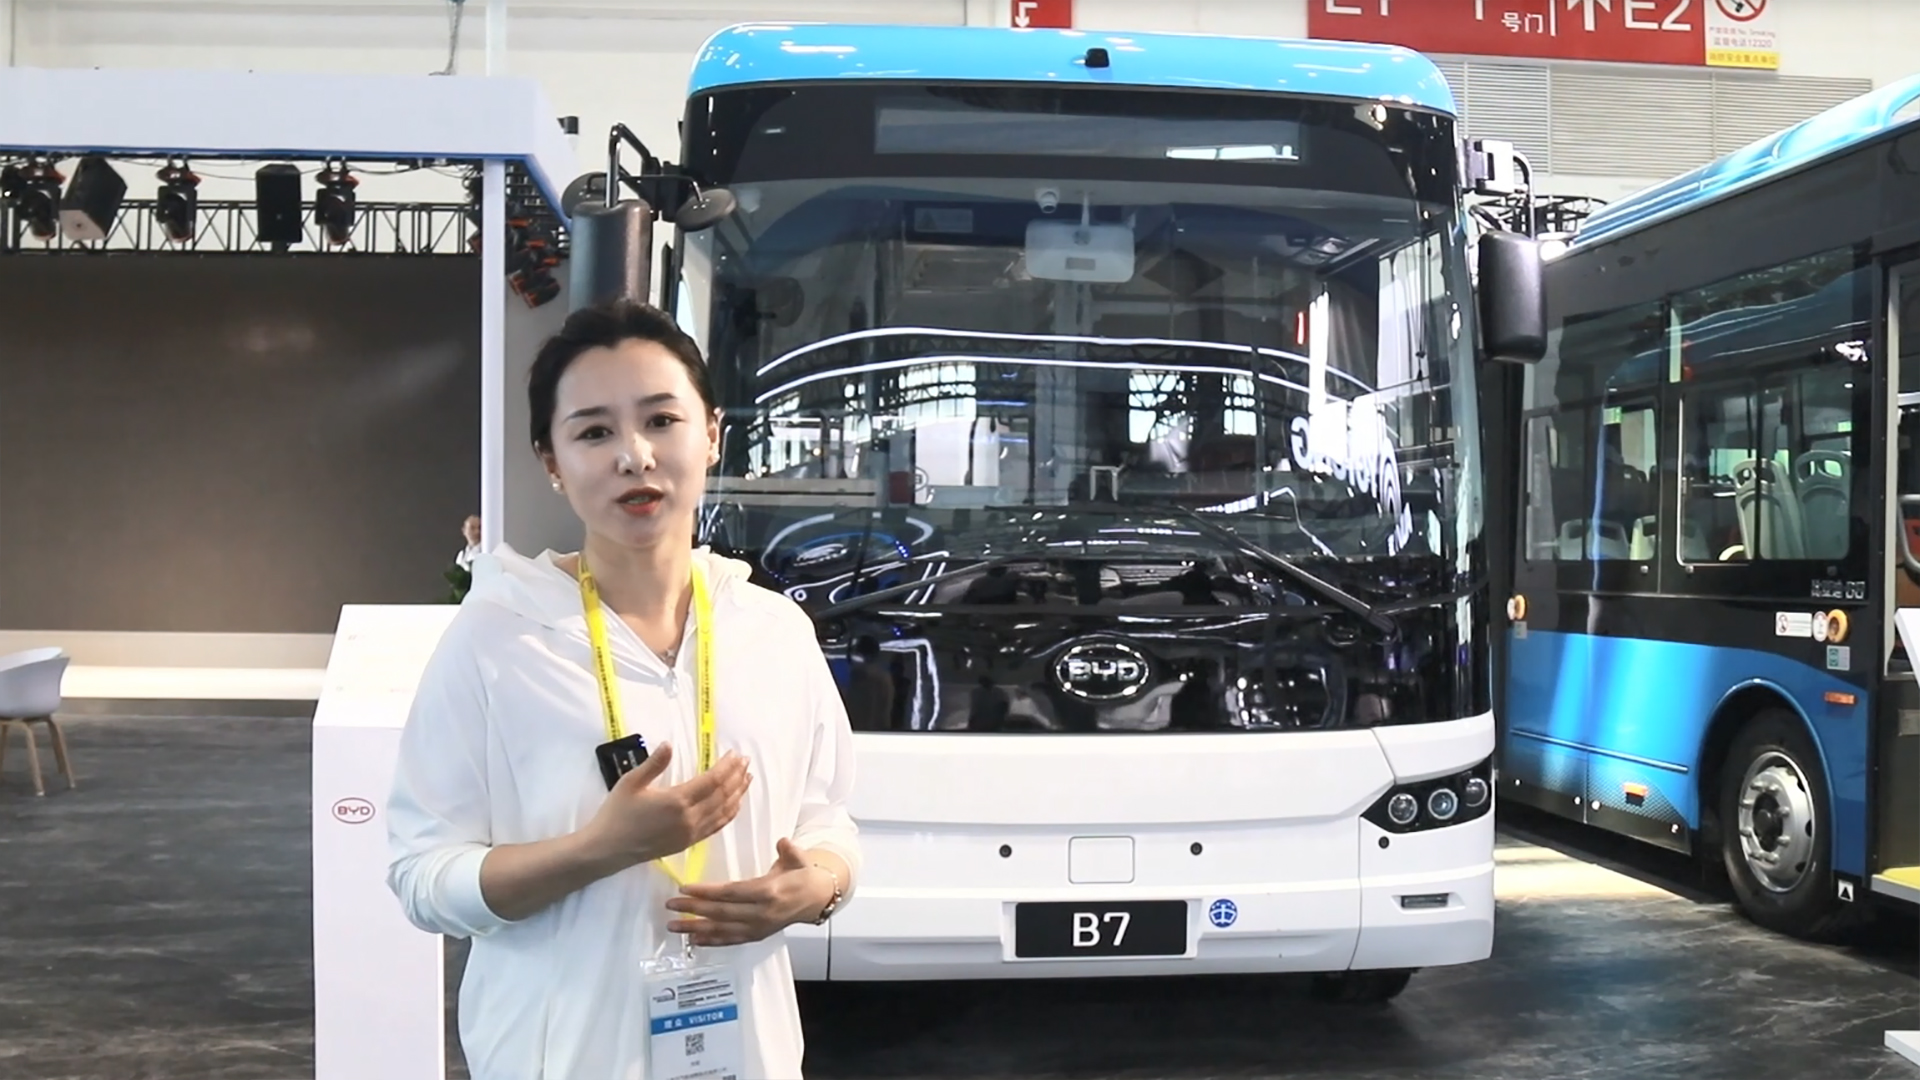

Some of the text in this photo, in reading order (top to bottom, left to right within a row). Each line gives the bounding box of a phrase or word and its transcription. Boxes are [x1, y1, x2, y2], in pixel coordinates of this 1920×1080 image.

[1501, 12, 1544, 33] 号门
[1068, 659, 1139, 681] BYD
[338, 806, 371, 815] BYD
[1072, 911, 1131, 947] B7
[688, 1011, 724, 1025] VISITOR
